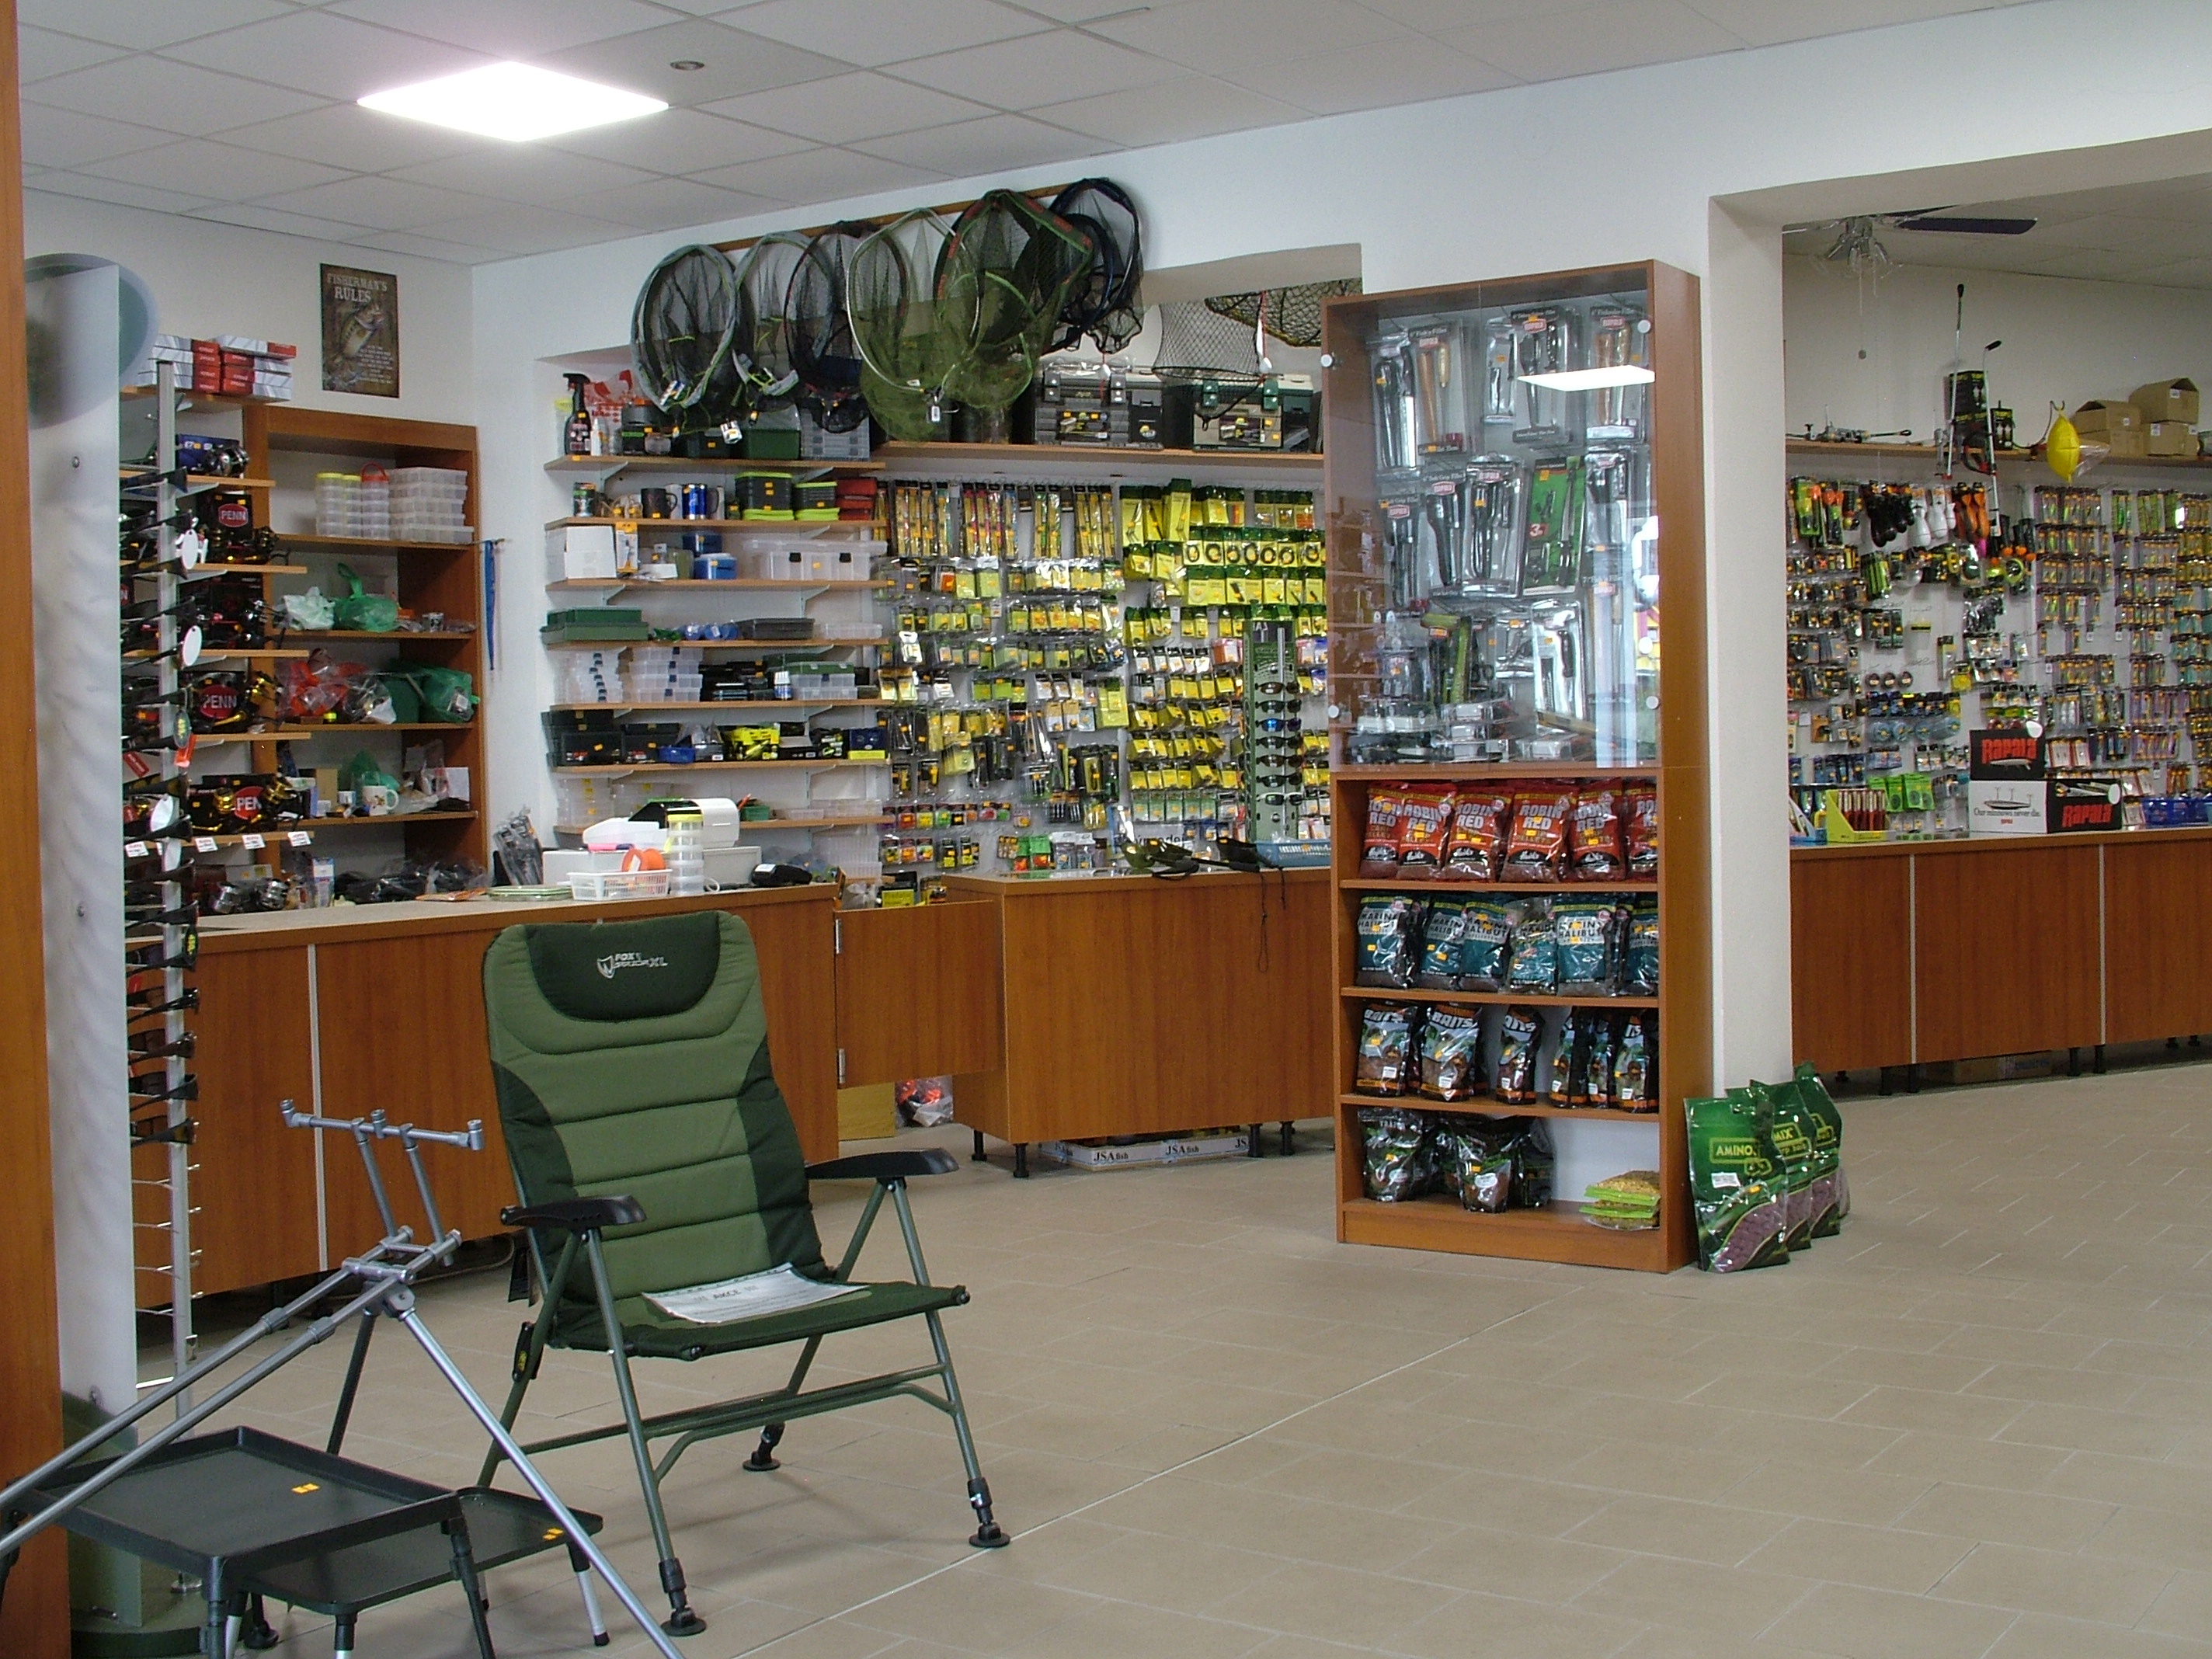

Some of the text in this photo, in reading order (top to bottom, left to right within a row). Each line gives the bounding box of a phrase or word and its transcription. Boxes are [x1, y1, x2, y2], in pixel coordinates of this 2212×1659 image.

[327, 273, 388, 292] FISHERMAN'S
[334, 286, 372, 303] RULES
[221, 510, 246, 520] PENN
[1982, 739, 2037, 764] RAPALA
[236, 797, 263, 811] PEN
[1519, 804, 1563, 819] ROBIN
[1370, 812, 1396, 827] RED
[1456, 814, 1484, 829] RED
[2062, 803, 2113, 828] RAPALA
[1364, 1009, 1404, 1022] BAITS
[1432, 1011, 1474, 1028] BAITS
[1504, 1014, 1537, 1032] AITS
[1166, 1145, 1199, 1156] JSA fish
[1235, 1138, 1249, 1148] JS
[1094, 1152, 1115, 1162] JSA
